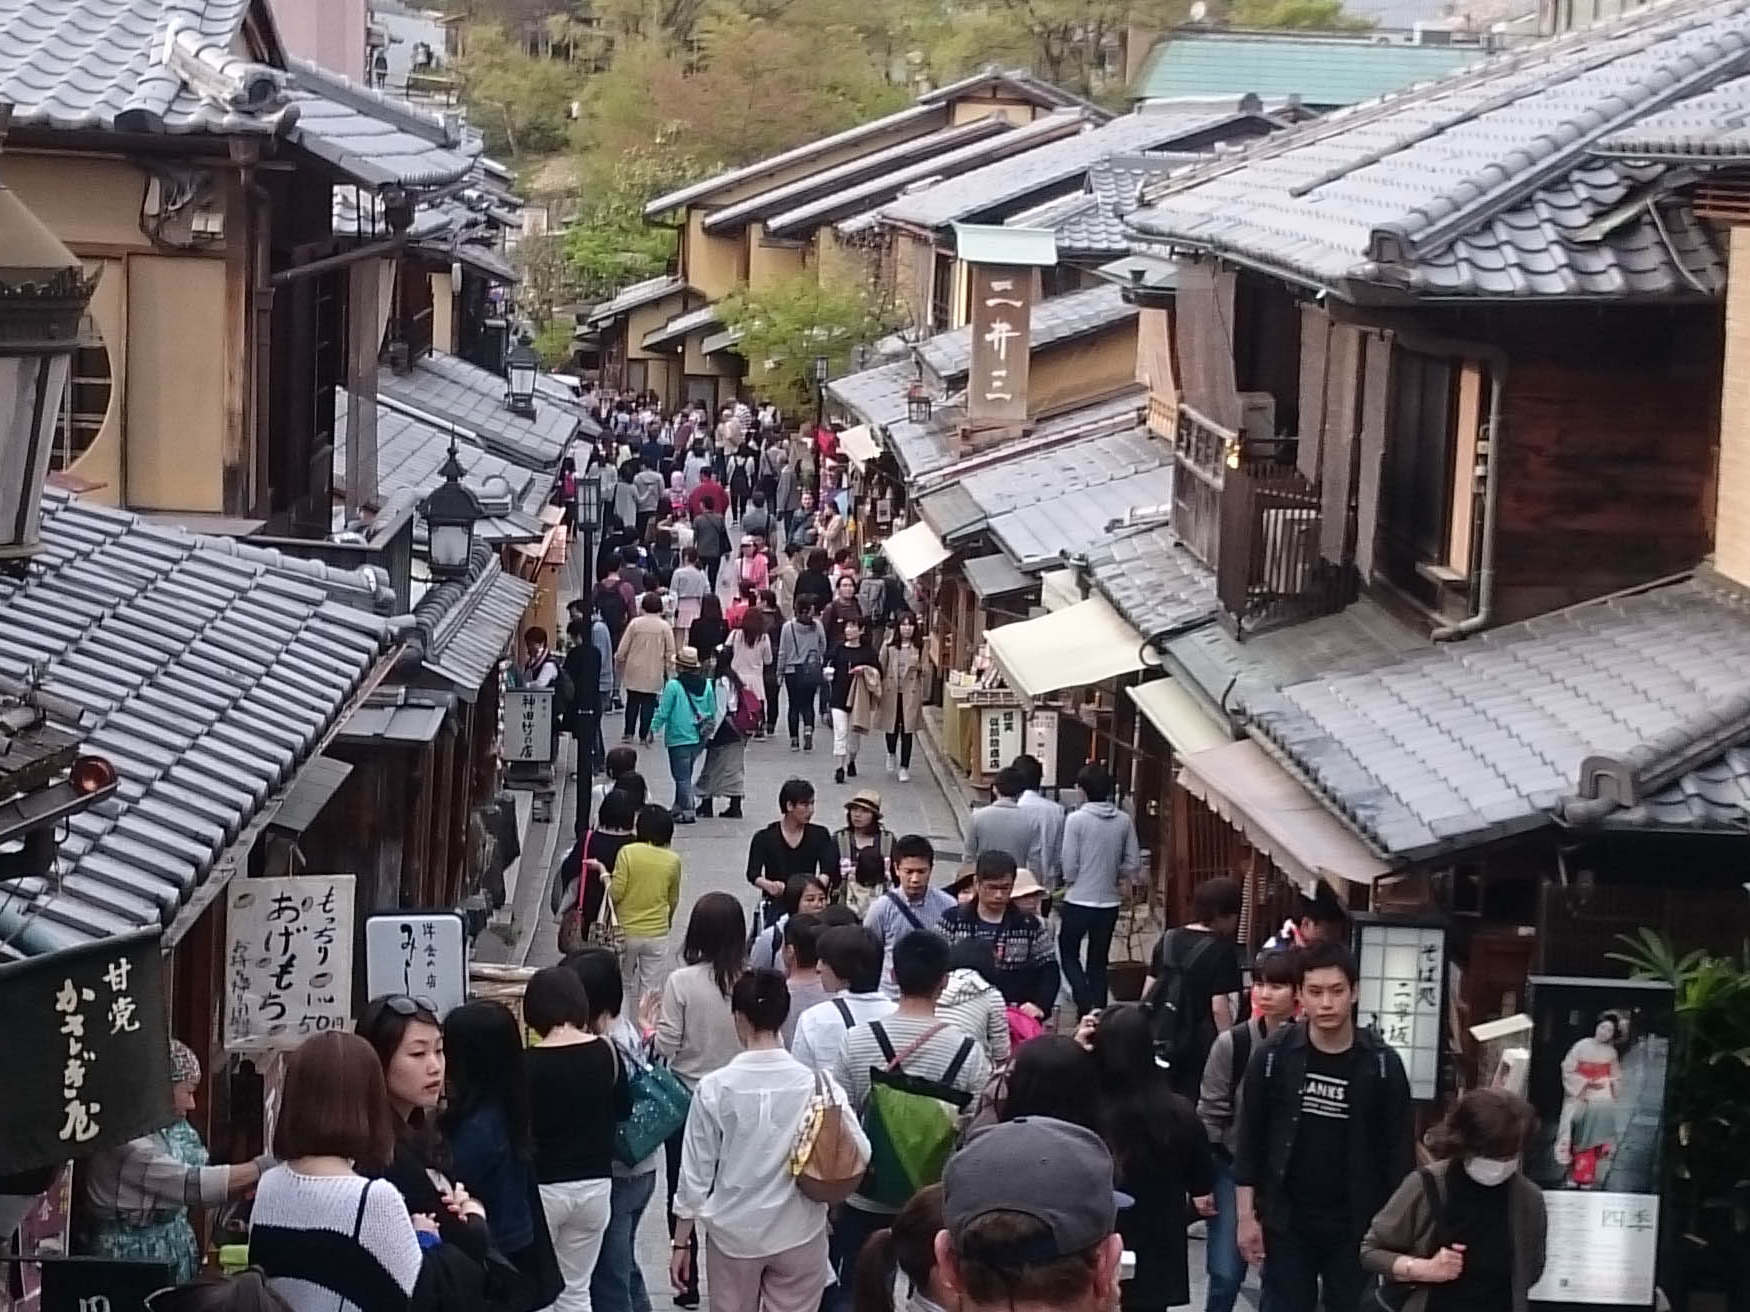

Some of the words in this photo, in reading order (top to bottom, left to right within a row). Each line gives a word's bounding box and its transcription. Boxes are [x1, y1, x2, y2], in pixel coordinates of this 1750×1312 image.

[985, 280, 1024, 401] 二井三
[258, 890, 308, 1021] あげもち
[313, 885, 337, 967] もっちり
[101, 957, 140, 1035] 甘党
[298, 1013, 344, 1034] 50円
[55, 977, 101, 1143] かさぎ屋
